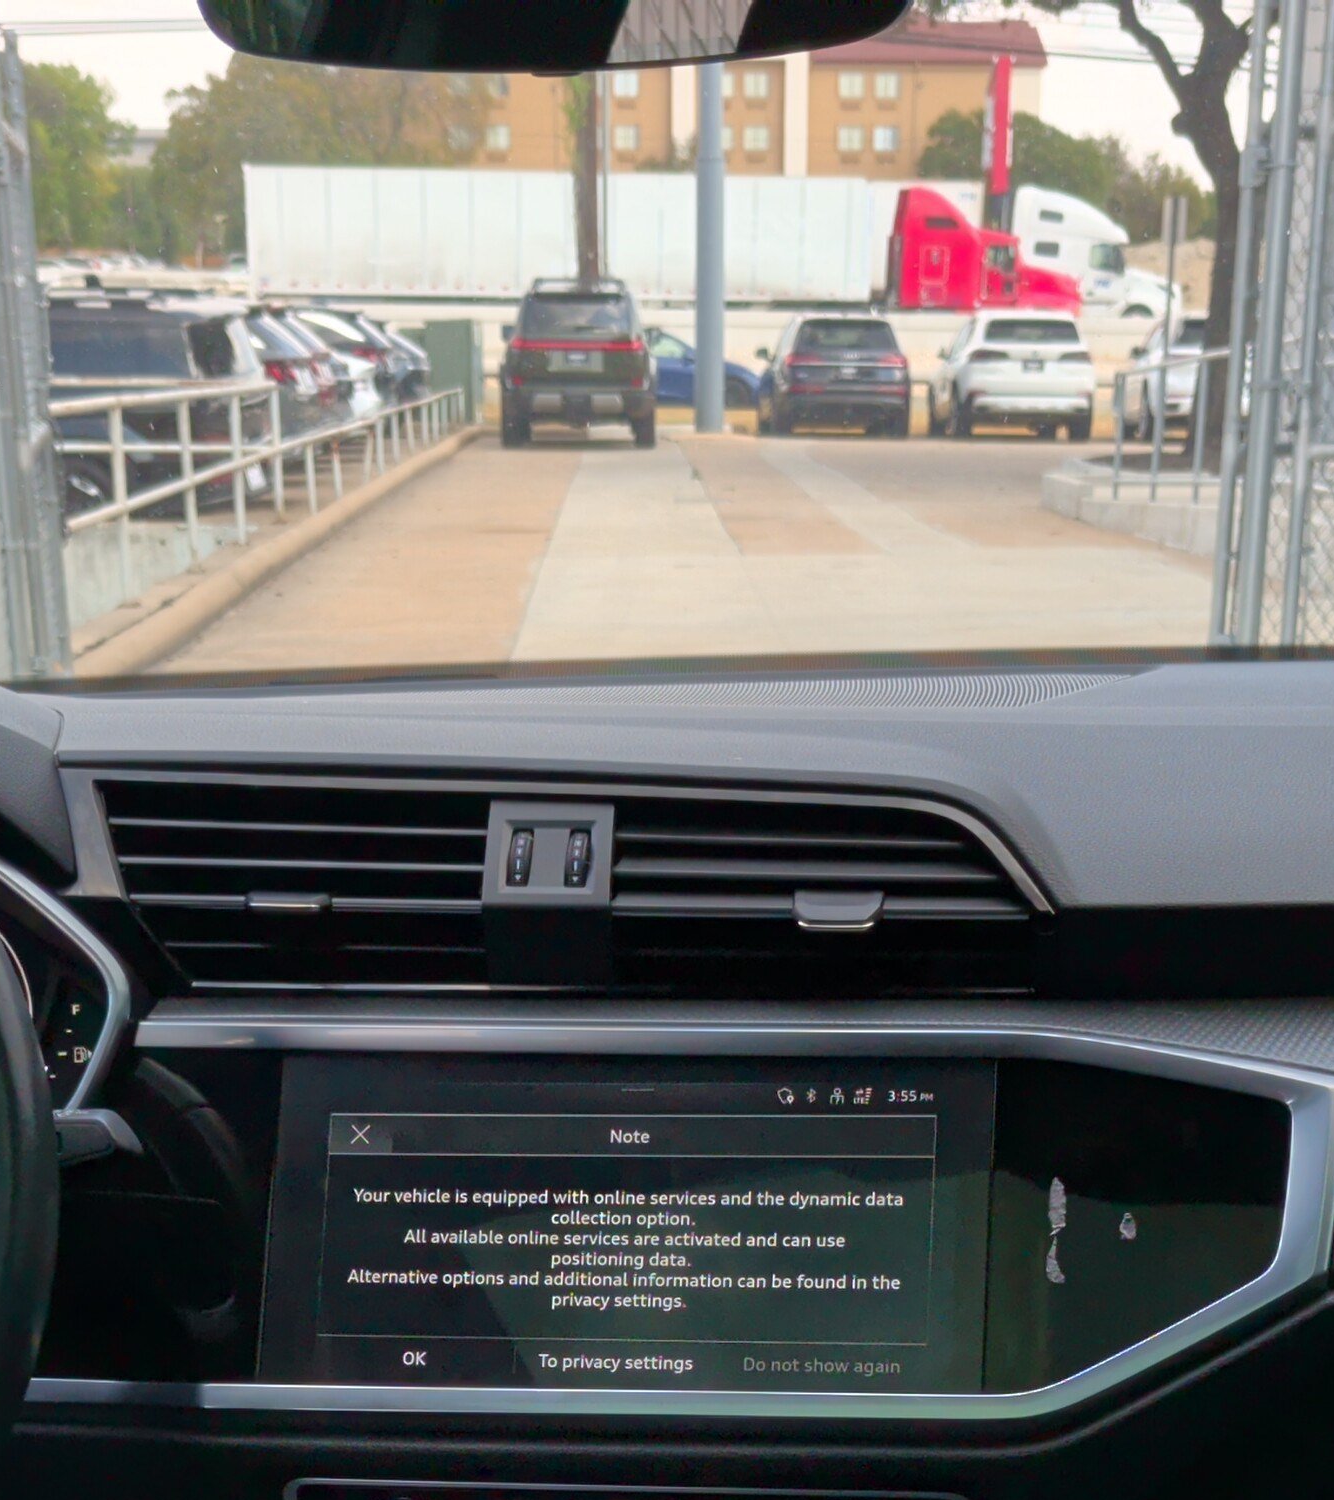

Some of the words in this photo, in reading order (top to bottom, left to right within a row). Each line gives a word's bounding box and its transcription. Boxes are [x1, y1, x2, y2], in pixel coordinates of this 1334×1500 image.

[72, 1004, 80, 1015] F
[887, 1090, 916, 1102] 3:55
[920, 1093, 934, 1102] PM
[610, 1129, 650, 1143] Note
[353, 1188, 390, 1203] Your
[394, 1189, 450, 1203] vehicle
[455, 1189, 467, 1203] is
[472, 1189, 548, 1207] equipped
[553, 1190, 589, 1204] with
[594, 1190, 645, 1204] online
[650, 1191, 716, 1205] services
[721, 1191, 751, 1206] and
[757, 1191, 784, 1206] the
[789, 1191, 860, 1209] dynamic
[865, 1192, 903, 1206] data
[551, 1211, 631, 1225] collection
[636, 1212, 696, 1228] option.
[404, 1229, 426, 1244] All
[430, 1229, 503, 1245] available
[508, 1230, 559, 1245] online
[564, 1231, 628, 1245] services
[634, 1235, 659, 1246] are
[664, 1232, 741, 1247] activated
[746, 1233, 777, 1247] and
[782, 1236, 811, 1247] can
[817, 1236, 846, 1247] use
[551, 1252, 644, 1269] positioning
[649, 1252, 692, 1267] data.
[347, 1269, 438, 1284] Alternative
[442, 1271, 504, 1288] options
[509, 1271, 539, 1285] and
[544, 1271, 628, 1286] additional
[632, 1273, 732, 1288] information
[737, 1277, 766, 1288] can
[772, 1274, 791, 1289] be
[797, 1274, 847, 1290] found
[852, 1275, 867, 1290] in
[872, 1275, 900, 1290] the
[551, 1292, 610, 1310] privacy
[614, 1294, 687, 1311] settings.
[402, 1351, 427, 1365] OK
[538, 1354, 557, 1368] To
[562, 1354, 620, 1372] privacy
[625, 1355, 693, 1373] settings
[743, 1357, 765, 1372] Do
[771, 1358, 799, 1372] not
[804, 1358, 849, 1372] show
[854, 1359, 900, 1377] again
